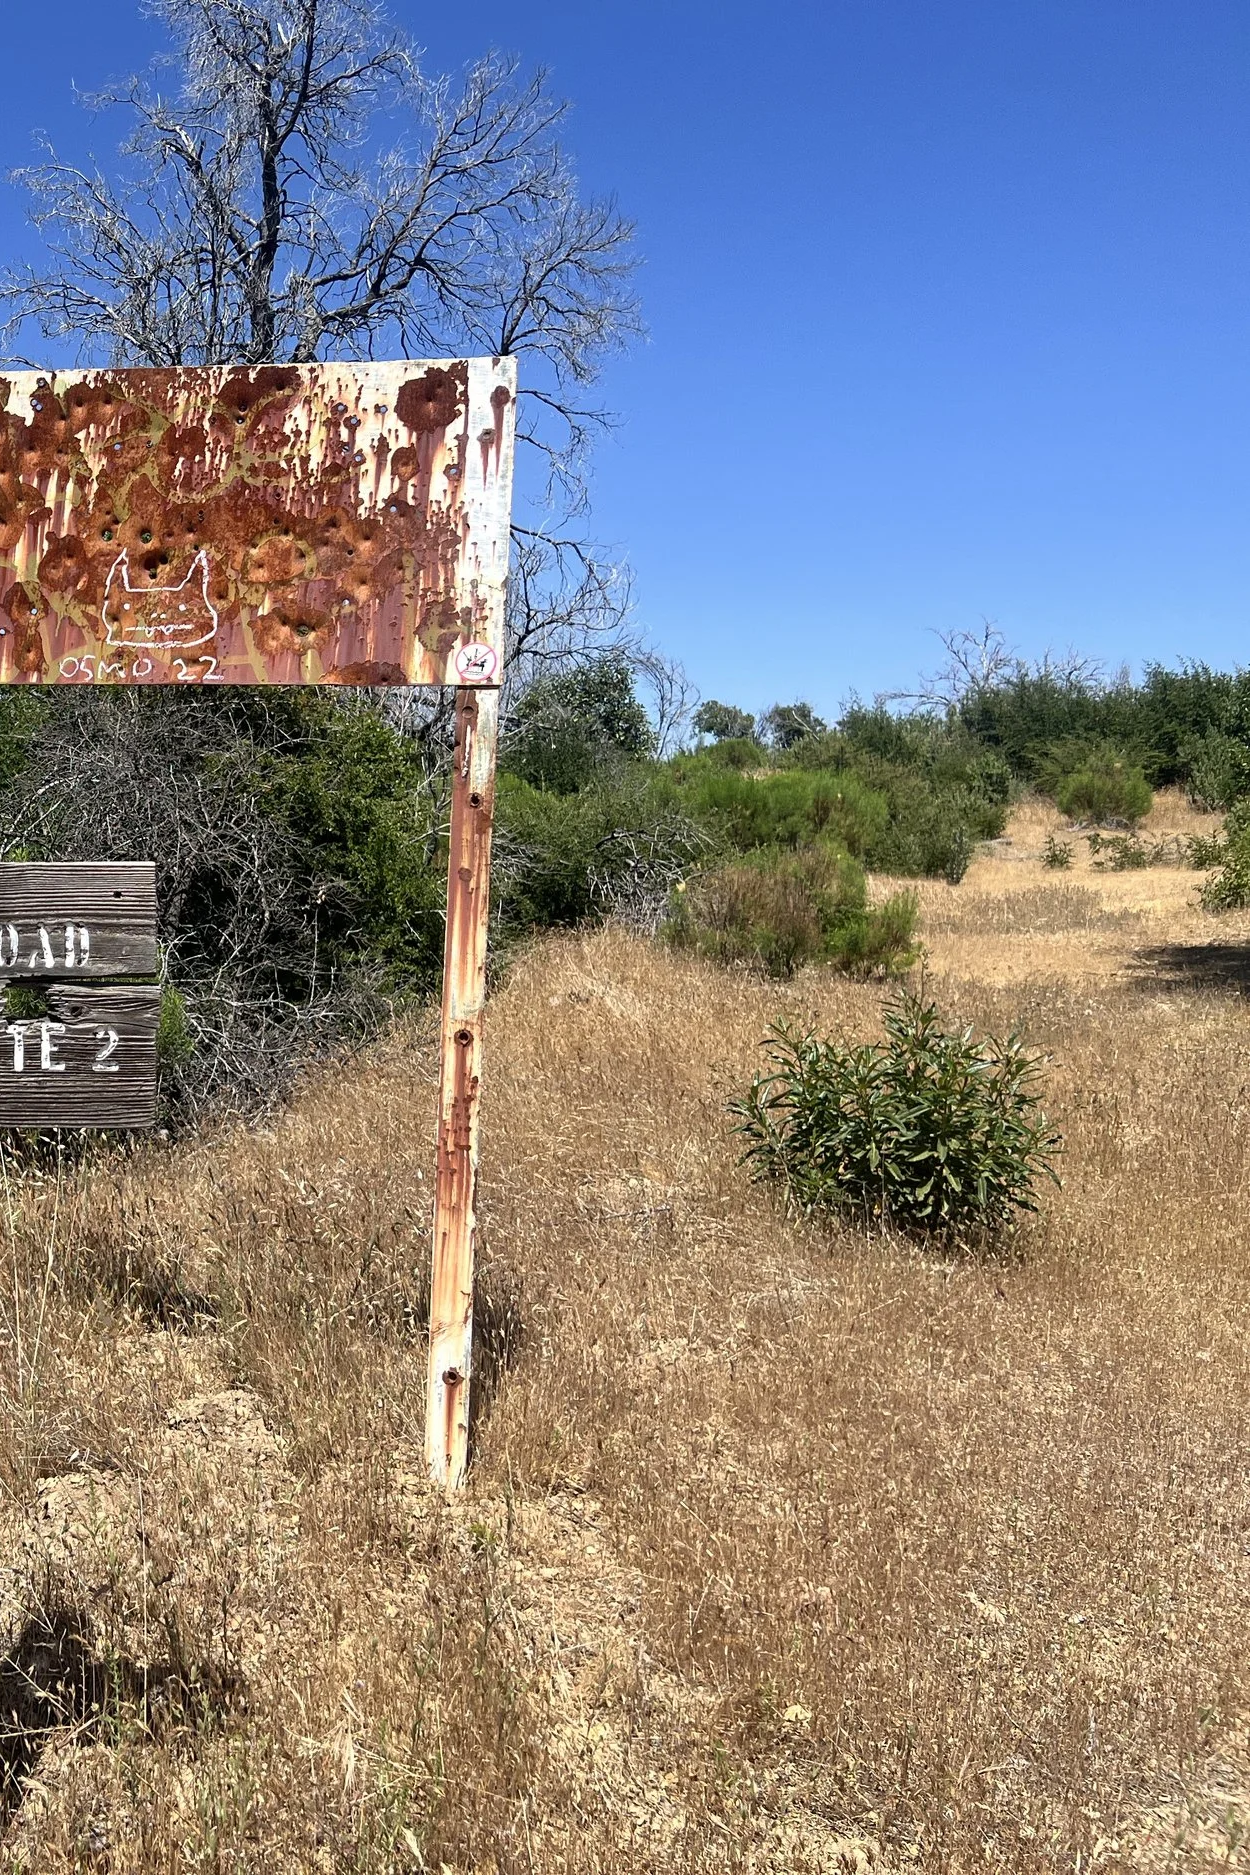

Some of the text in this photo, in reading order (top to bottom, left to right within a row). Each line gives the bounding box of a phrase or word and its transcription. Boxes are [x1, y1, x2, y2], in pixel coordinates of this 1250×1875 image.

[59, 655, 224, 681] OSMO 22
[92, 1025, 119, 1071] 2
